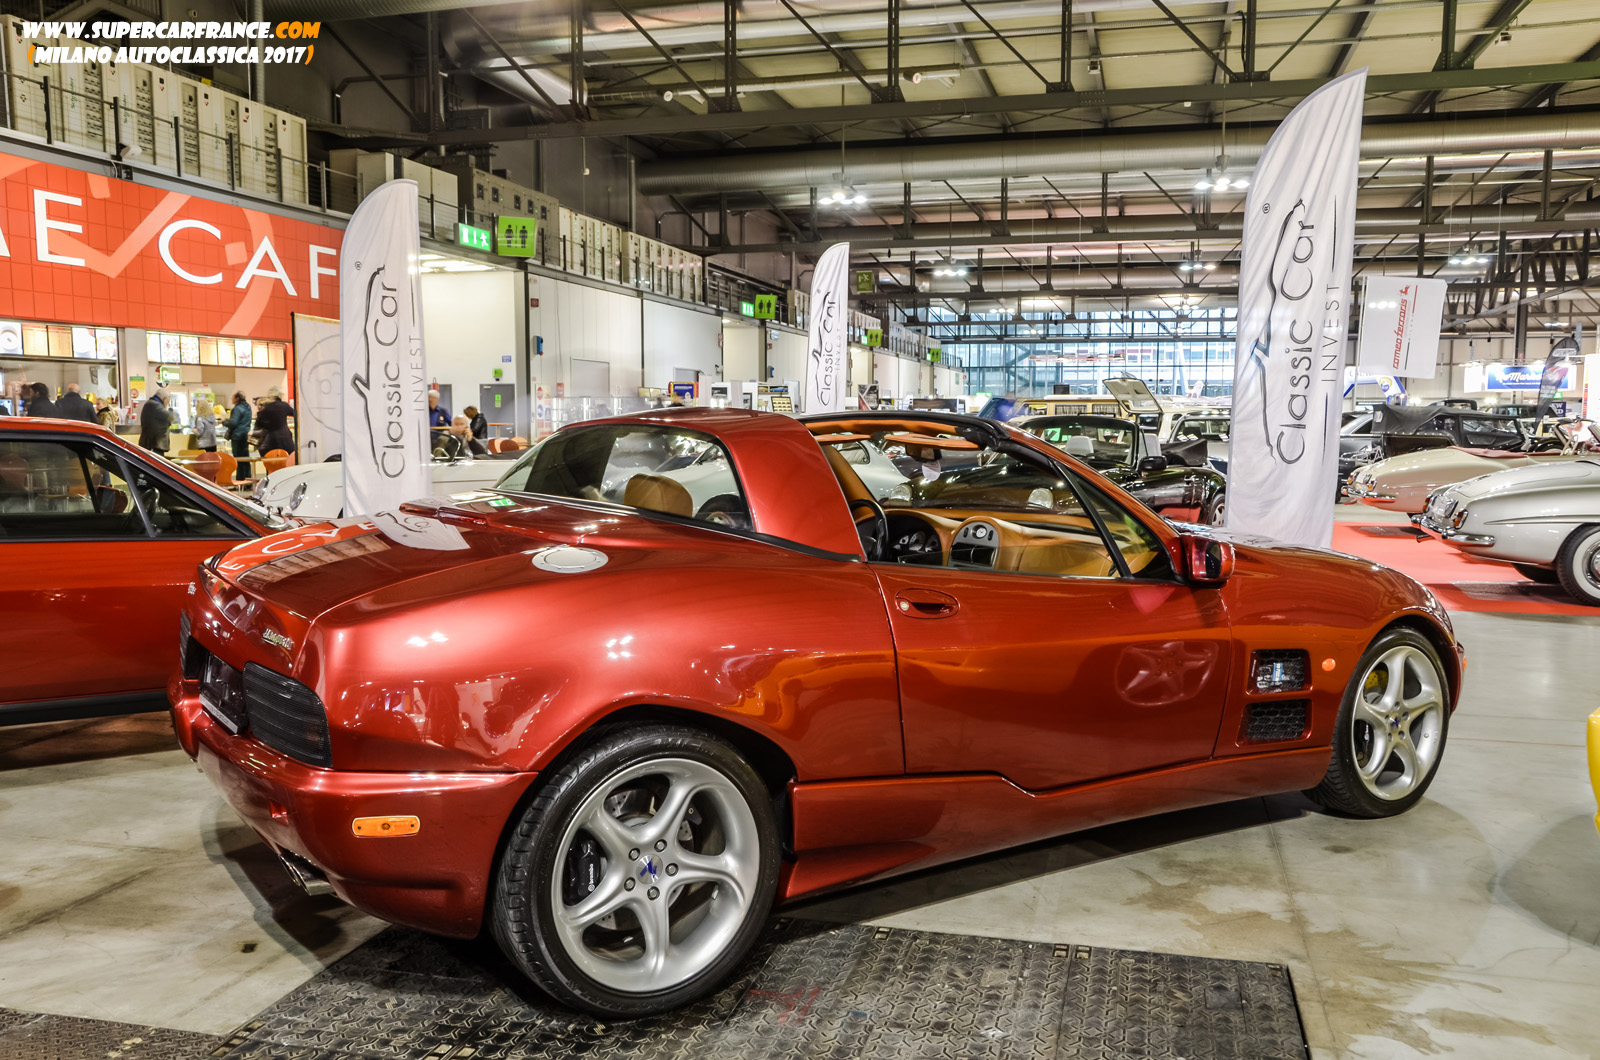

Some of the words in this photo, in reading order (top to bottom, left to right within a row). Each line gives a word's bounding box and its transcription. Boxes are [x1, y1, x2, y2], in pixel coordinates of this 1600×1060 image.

[0, 189, 86, 267] E
[158, 219, 337, 299] CAF
[1281, 220, 1315, 300] Car
[374, 281, 399, 347] Car
[823, 300, 836, 333] Car
[1321, 284, 1340, 382] INVEST
[408, 335, 424, 412] INVEST
[820, 341, 834, 406] Classic
[1277, 319, 1313, 464] Classic
[381, 361, 406, 478] Classic
